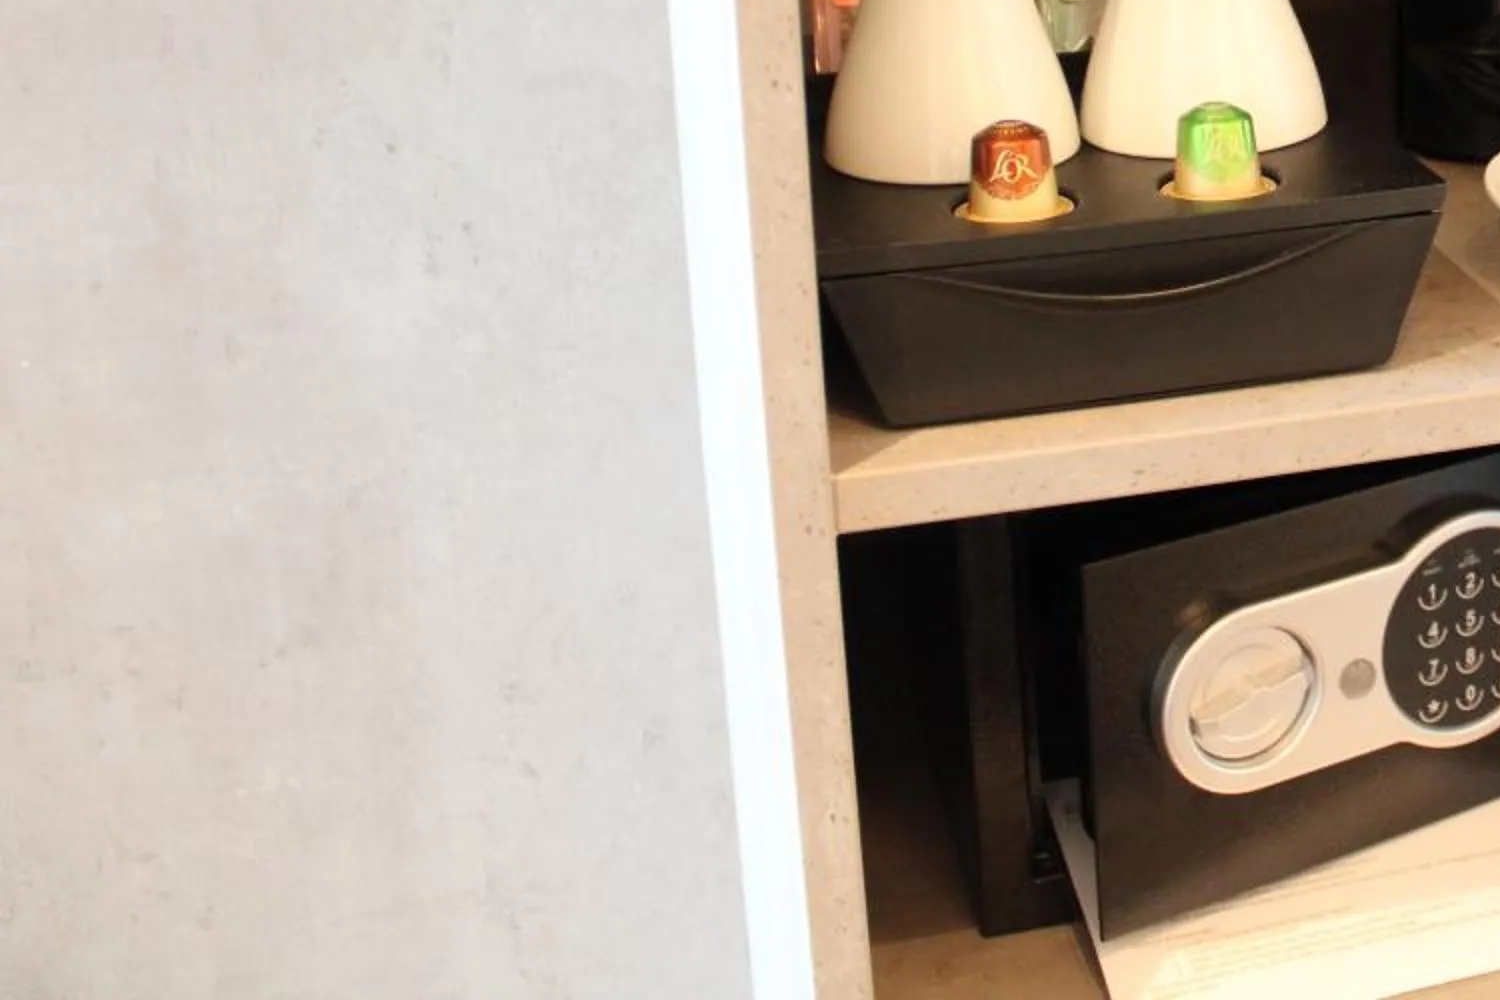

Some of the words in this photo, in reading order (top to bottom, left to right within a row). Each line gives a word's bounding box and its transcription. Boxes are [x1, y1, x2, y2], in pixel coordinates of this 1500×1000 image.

[1427, 583, 1437, 600] 1
[1465, 571, 1477, 589] 2
[1427, 621, 1440, 640] 4
[1465, 608, 1477, 625] 5
[1428, 658, 1440, 677] 7
[1465, 646, 1477, 664] 8
[1465, 684, 1477, 701] 0
